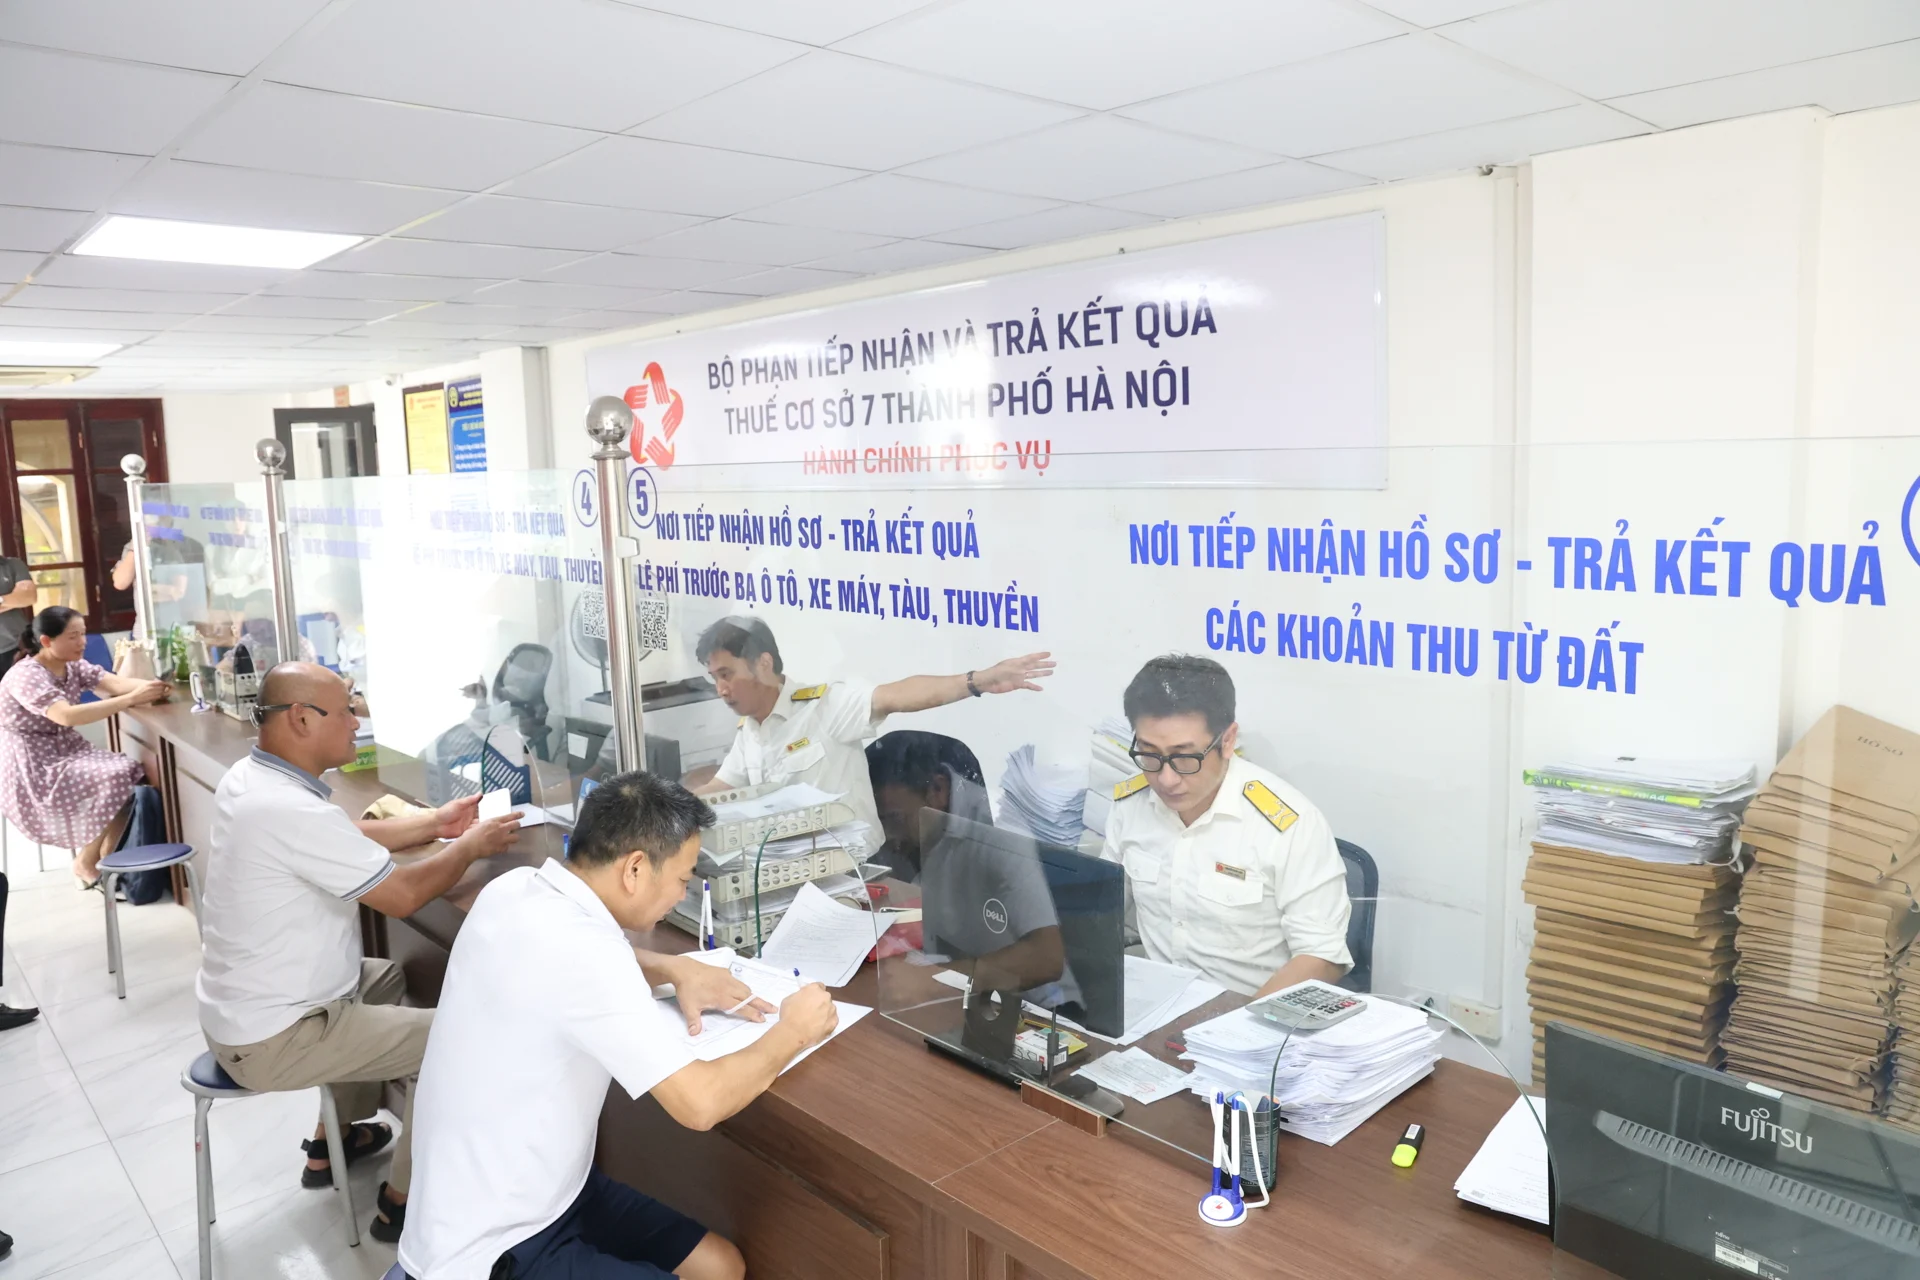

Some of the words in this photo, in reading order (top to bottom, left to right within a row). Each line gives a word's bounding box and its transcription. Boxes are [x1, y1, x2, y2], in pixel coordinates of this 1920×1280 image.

[708, 355, 734, 394] BỘ
[805, 335, 854, 378] TIẾP
[862, 328, 935, 375] NHẬN
[943, 319, 979, 358] VÀ
[987, 307, 1048, 357] TRẢ
[1058, 295, 1123, 350] KẾT
[1136, 283, 1217, 348] QUẢ
[724, 394, 778, 435] THUẾ
[785, 398, 814, 431] CƠ
[823, 388, 854, 429] SỞ
[862, 394, 875, 426] 7
[882, 383, 976, 424] THÀNH
[987, 366, 1053, 417] PHỐ
[1066, 365, 1114, 413] HÀ
[1125, 359, 1190, 417] NỘI
[804, 445, 856, 475] HÀNH
[864, 441, 931, 474] CHÍNH
[1015, 439, 1051, 477] VỤ
[581, 481, 592, 516] 4
[635, 479, 649, 517] 5
[656, 511, 680, 540] NƠI
[683, 503, 714, 542] TIẾP
[719, 509, 764, 551] NHẬN
[769, 505, 792, 547] HỒ
[798, 515, 822, 550] SƠ
[828, 533, 836, 541] -
[841, 508, 880, 552] TRẢ
[885, 506, 924, 555] KẾT
[932, 509, 980, 561] QUẢ
[1129, 520, 1179, 566] NƠI
[1188, 511, 1256, 570] TIẾP
[1268, 518, 1365, 584] NHẬN
[1379, 514, 1430, 580] HỒ
[1444, 528, 1501, 584] SƠ
[1516, 560, 1532, 571] -
[1547, 518, 1637, 592] TRẢ
[1654, 516, 1751, 597] KẾT
[1769, 520, 1886, 608] QUẢ
[637, 559, 652, 597] LỆ
[656, 560, 679, 593] PHÍ
[682, 561, 730, 599] TRƯỚC
[735, 571, 756, 608] BẠ
[761, 567, 772, 603] Ô
[776, 569, 804, 610] TÔ,
[808, 577, 832, 610] XE
[838, 574, 885, 620] MÁY,
[889, 578, 938, 628] TÀU,
[943, 580, 1039, 633] THUYỀN
[1206, 600, 1266, 655] CÁC
[1277, 602, 1394, 668] KHOẢN
[1406, 623, 1479, 677] THU
[1492, 621, 1549, 684] TỪ
[1556, 620, 1644, 695] ĐẤT
[986, 908, 1005, 923] DELL
[1721, 1106, 1813, 1154] FUJITSU
